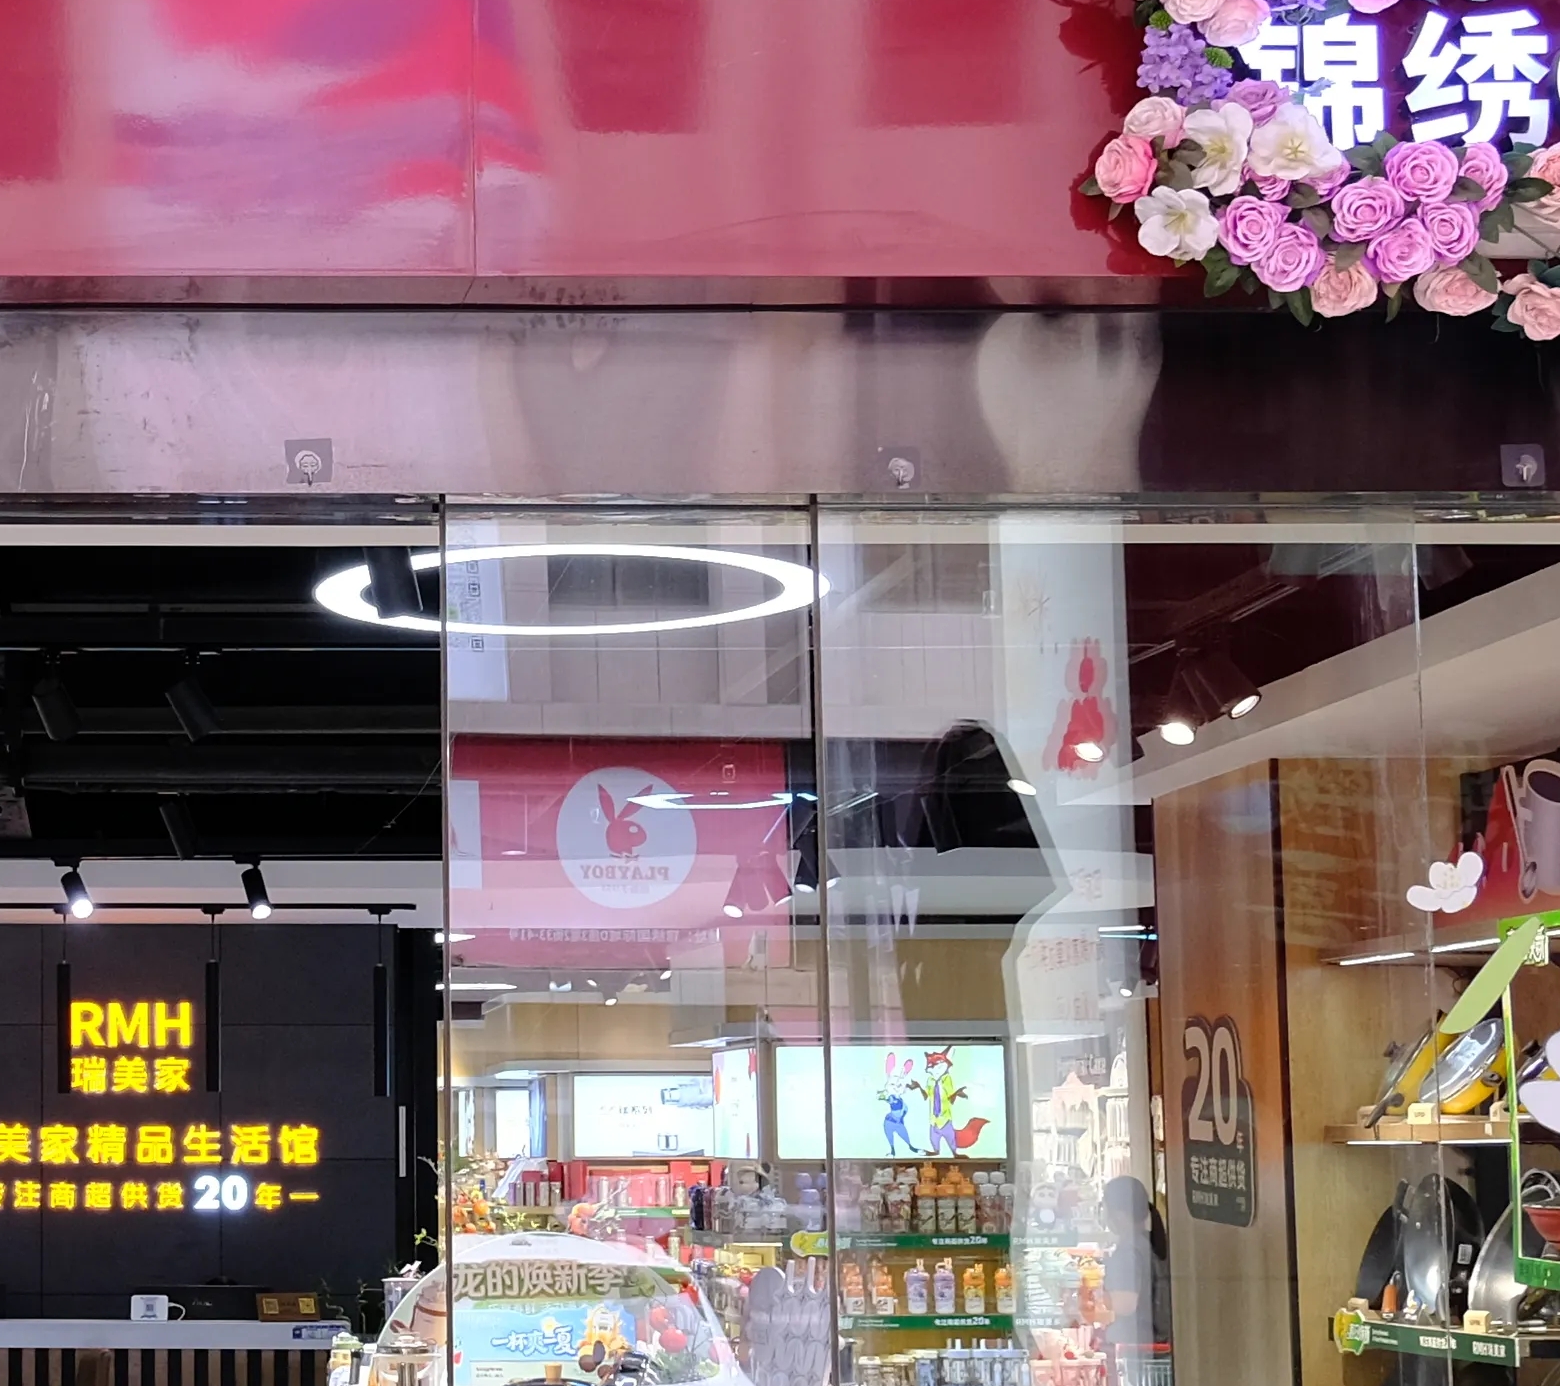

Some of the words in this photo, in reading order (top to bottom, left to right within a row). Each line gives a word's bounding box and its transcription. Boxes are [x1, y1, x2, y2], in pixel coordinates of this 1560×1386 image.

[69, 1001, 192, 1047] RMH
[69, 1055, 191, 1094] 瑞美家
[1190, 1155, 1247, 1191] 专注商超供货
